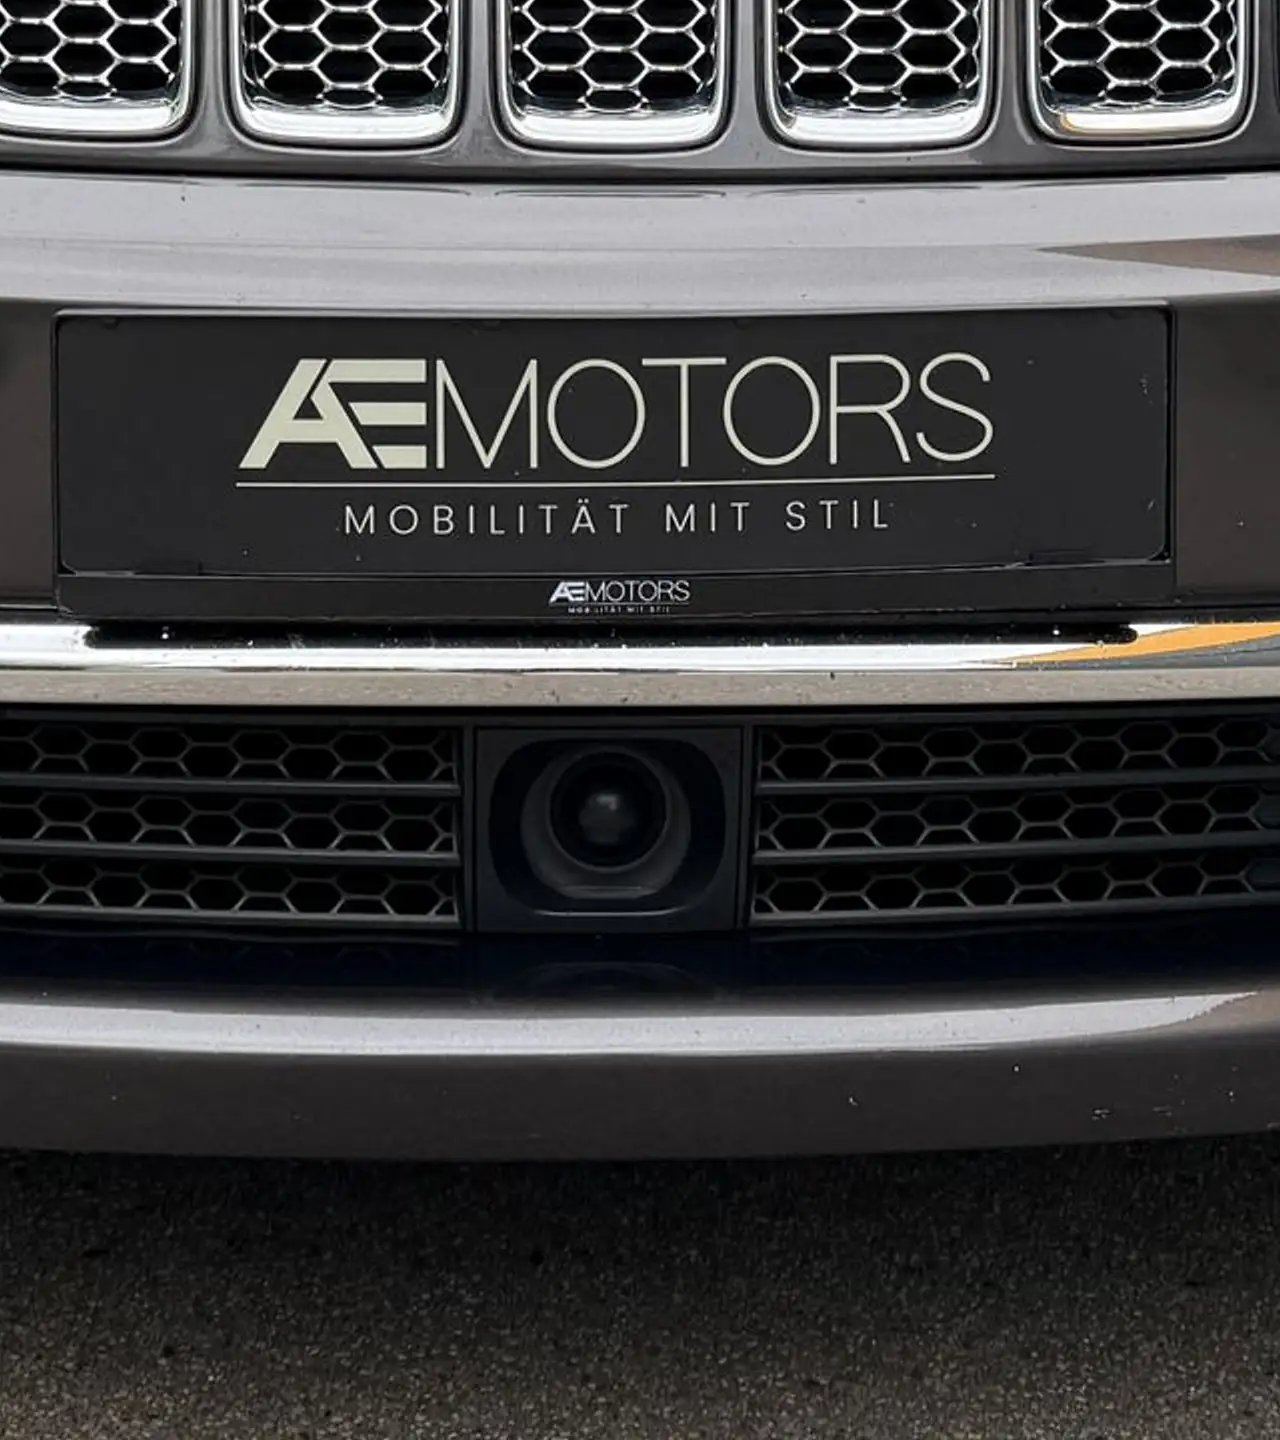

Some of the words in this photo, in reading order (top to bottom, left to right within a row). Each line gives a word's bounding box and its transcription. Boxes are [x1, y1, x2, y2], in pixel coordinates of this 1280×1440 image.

[345, 498, 628, 535] MOBILITÄT
[665, 502, 749, 533] MIT
[785, 499, 887, 531] STIL
